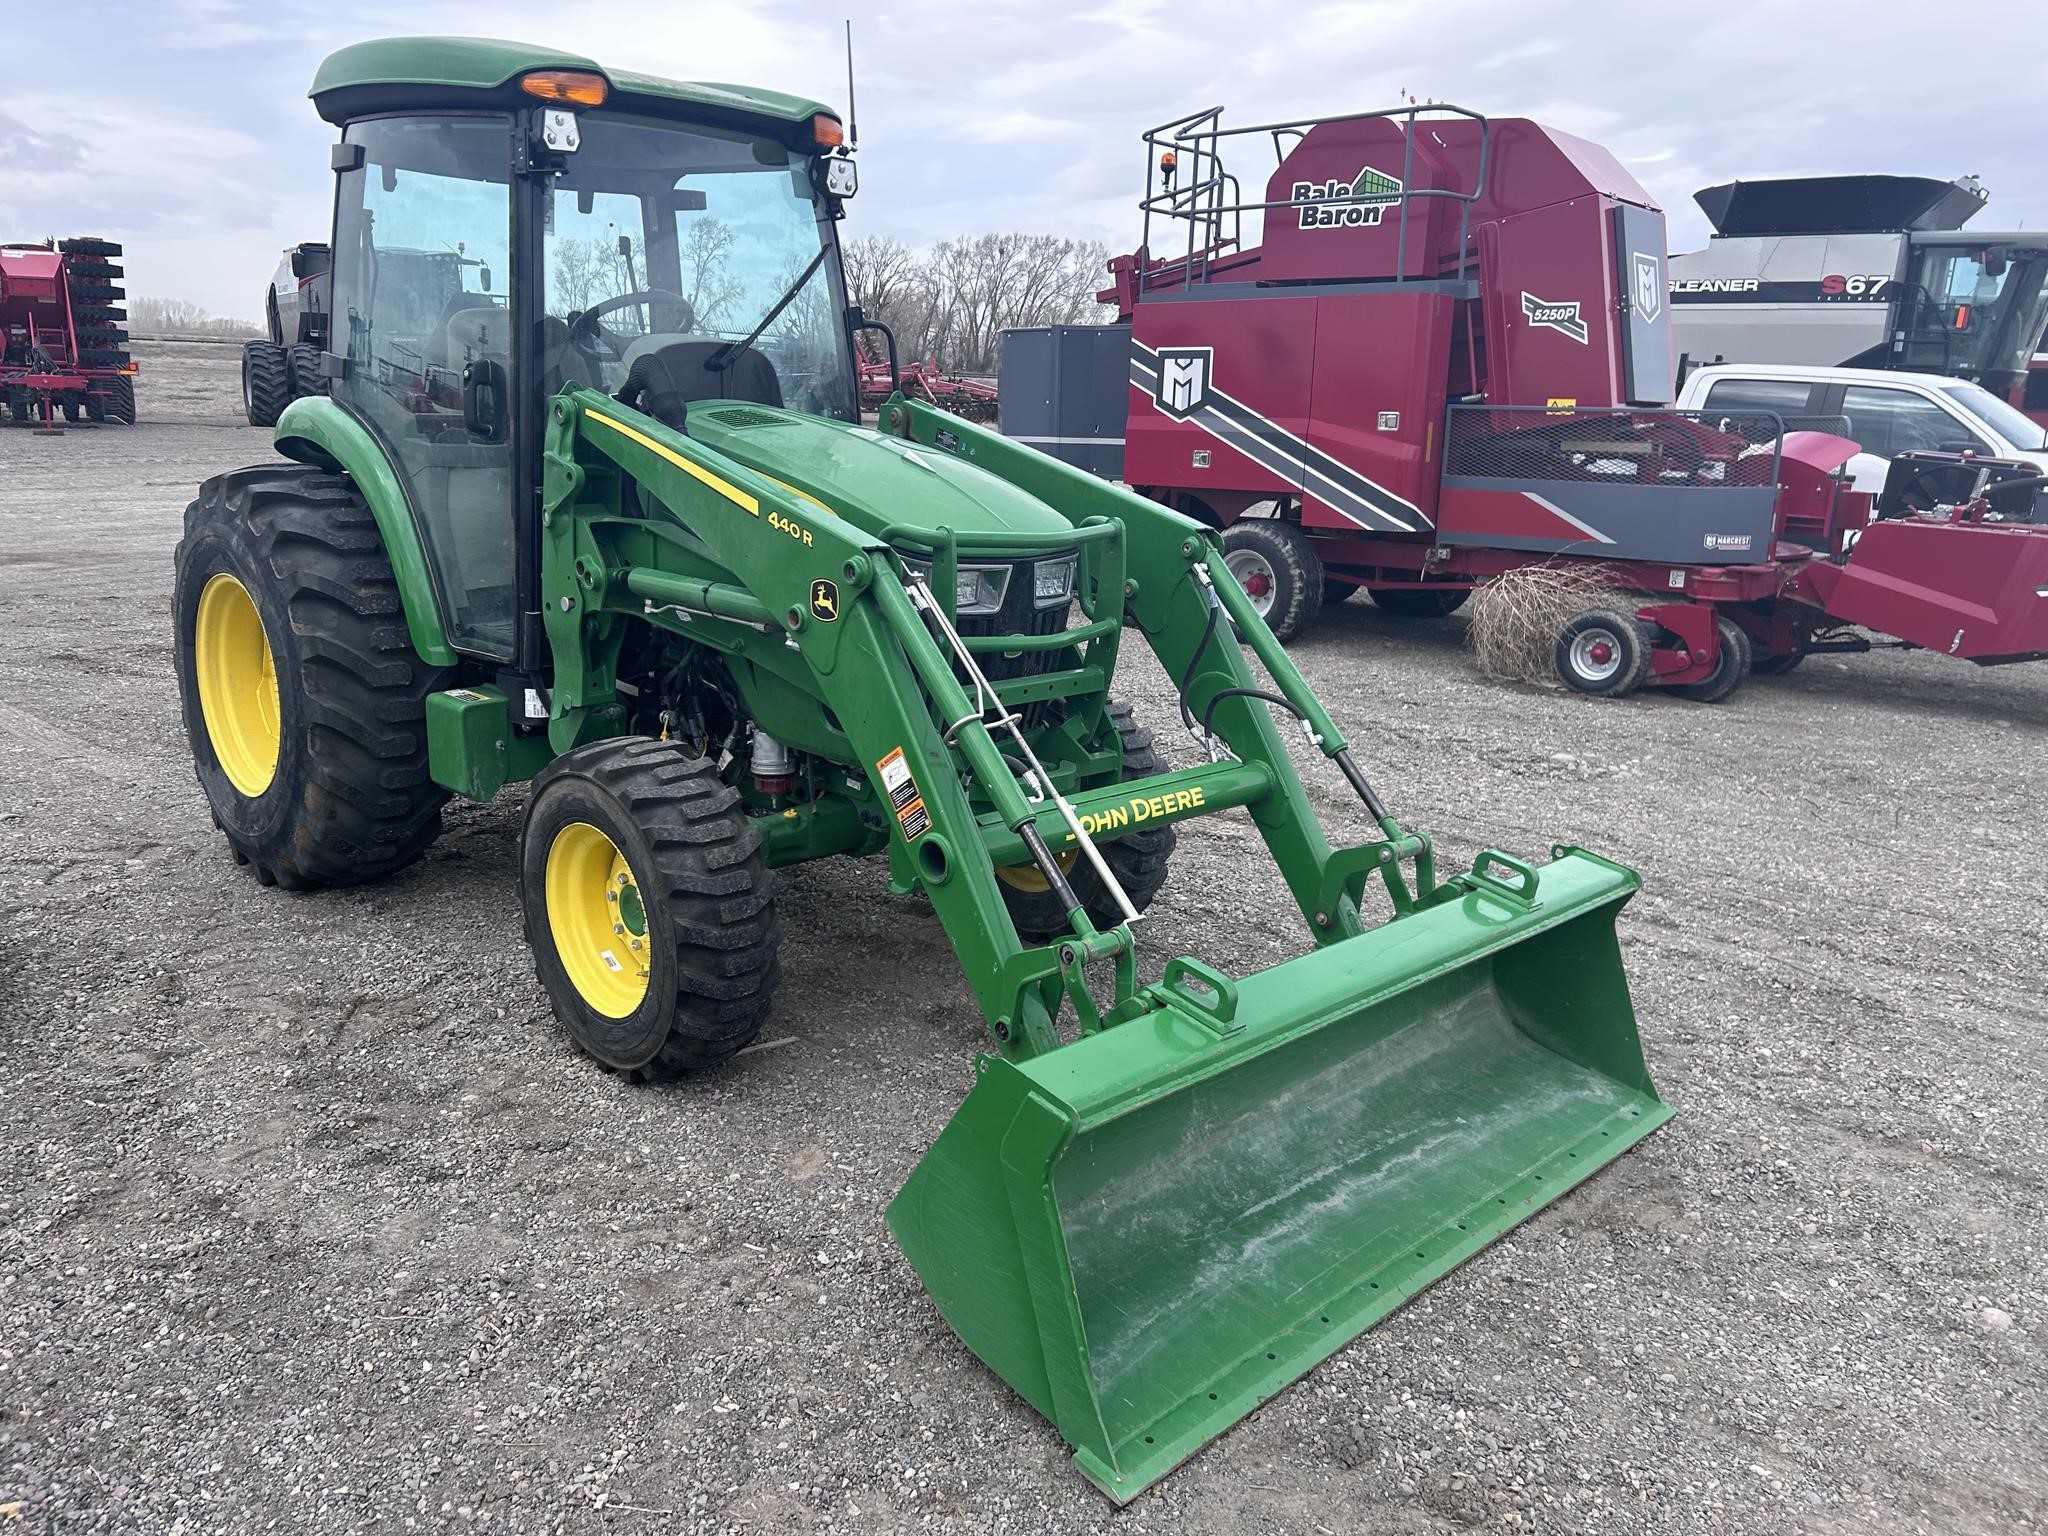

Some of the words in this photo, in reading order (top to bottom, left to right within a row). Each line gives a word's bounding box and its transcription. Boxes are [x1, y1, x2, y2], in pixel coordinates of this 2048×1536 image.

[1293, 182, 1350, 202] Bale
[1300, 204, 1381, 227] Baron
[1821, 274, 1890, 295] S67
[1533, 307, 1576, 321] 5250P
[1128, 786, 1206, 823] DEERE
